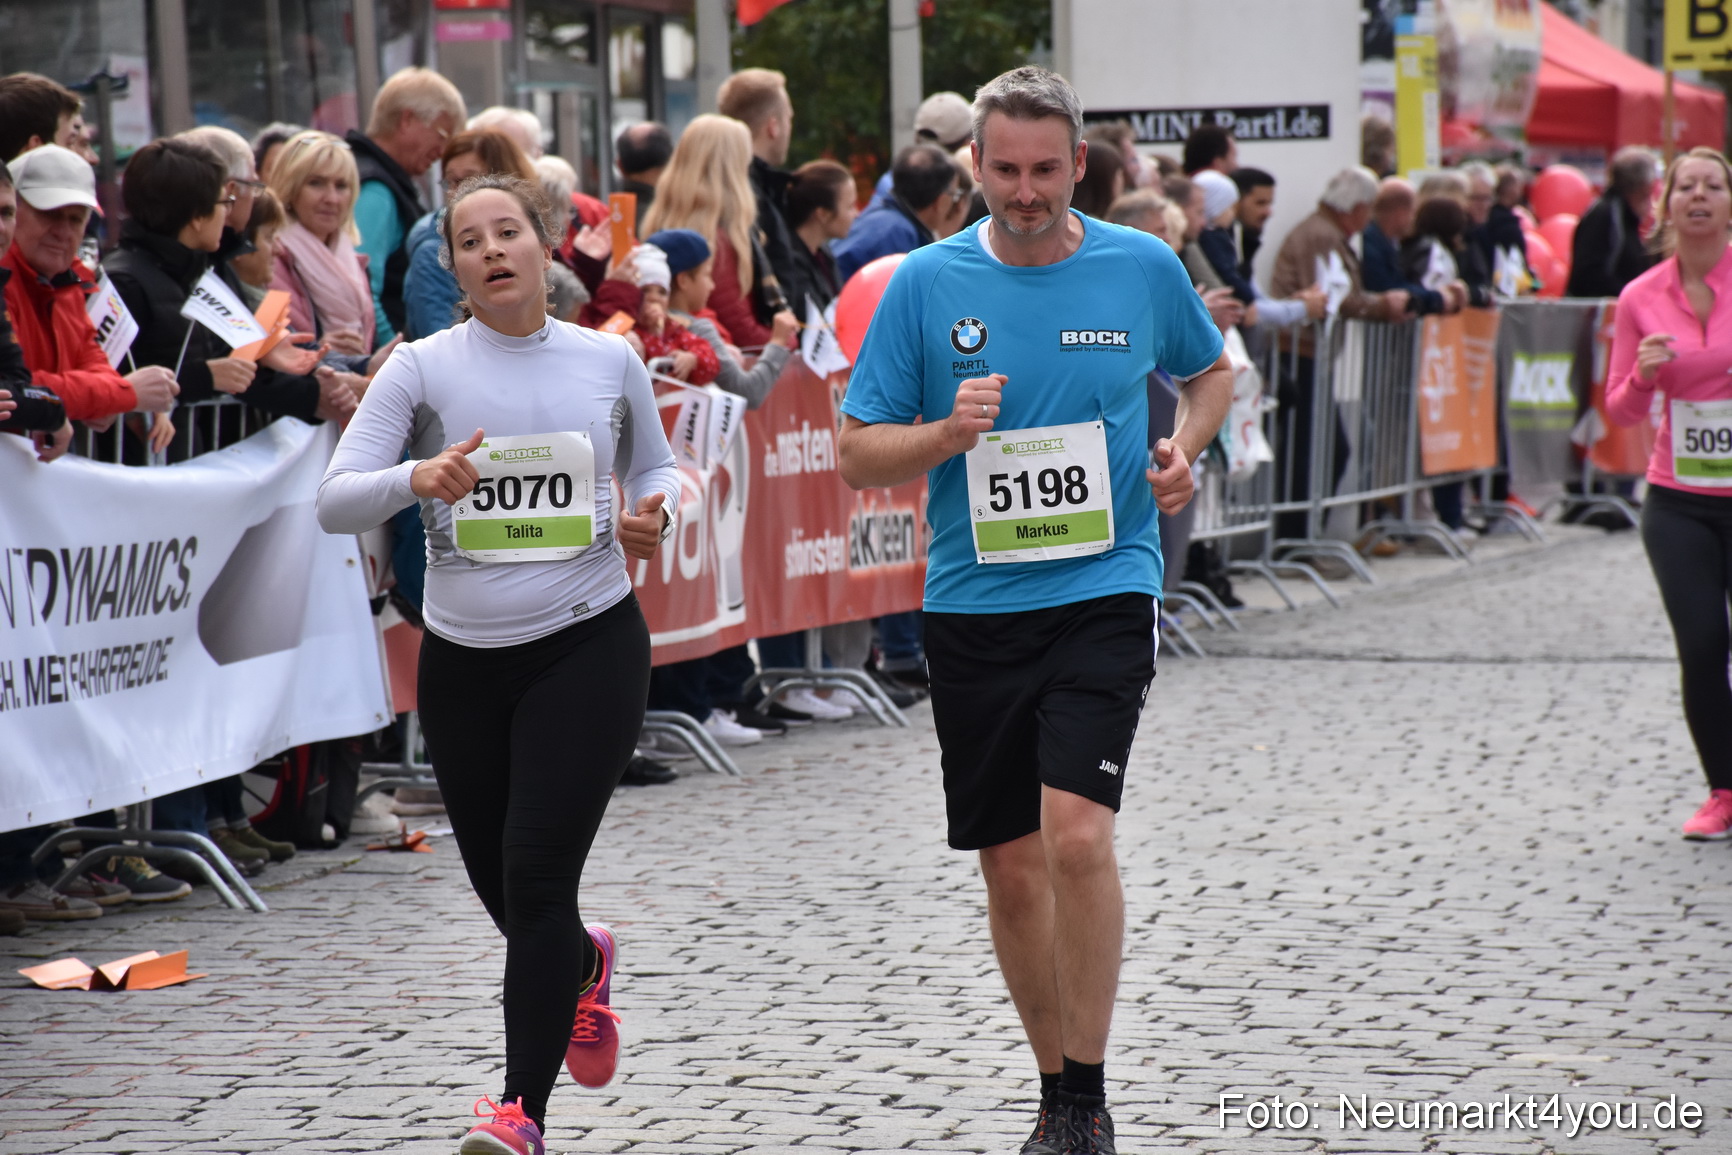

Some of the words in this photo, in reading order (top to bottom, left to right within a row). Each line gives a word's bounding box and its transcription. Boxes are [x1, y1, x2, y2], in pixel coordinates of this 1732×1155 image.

[953, 318, 985, 332] BMW
[1060, 330, 1131, 347] BOCK
[952, 359, 990, 371] PARTL
[953, 369, 990, 379] Neumarkt
[503, 446, 552, 460] BOCK
[1016, 438, 1064, 453] BOCK
[472, 473, 573, 511] 5070
[989, 465, 1089, 513] 5198
[505, 524, 543, 538] Talita
[1015, 523, 1069, 539] Markus
[1099, 760, 1119, 775] JAKO
